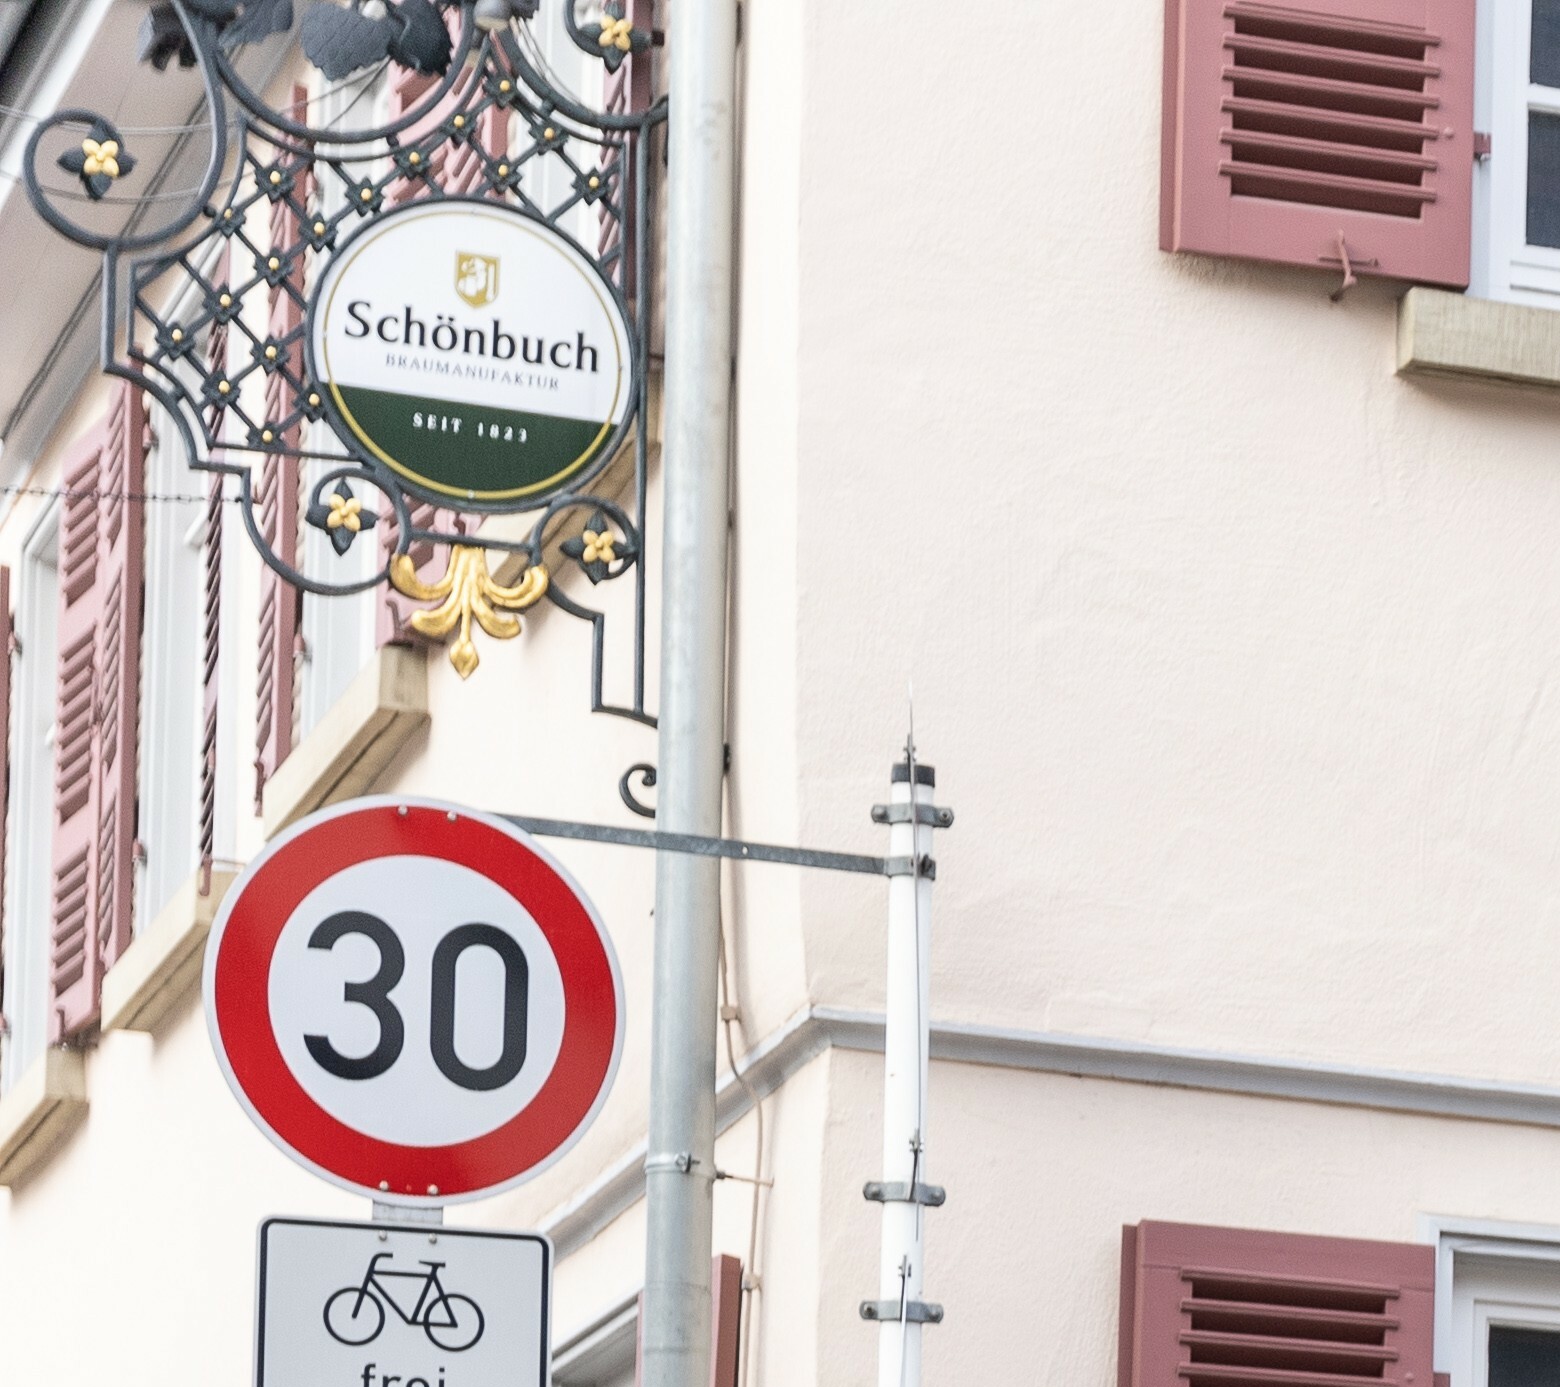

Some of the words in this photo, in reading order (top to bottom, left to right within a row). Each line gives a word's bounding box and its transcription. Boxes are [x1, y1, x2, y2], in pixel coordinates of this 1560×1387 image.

[344, 299, 599, 374] Schönbuch
[385, 352, 560, 391] BRAUMANUFAKTUR
[412, 411, 463, 434] SEIT
[304, 910, 529, 1092] 30
